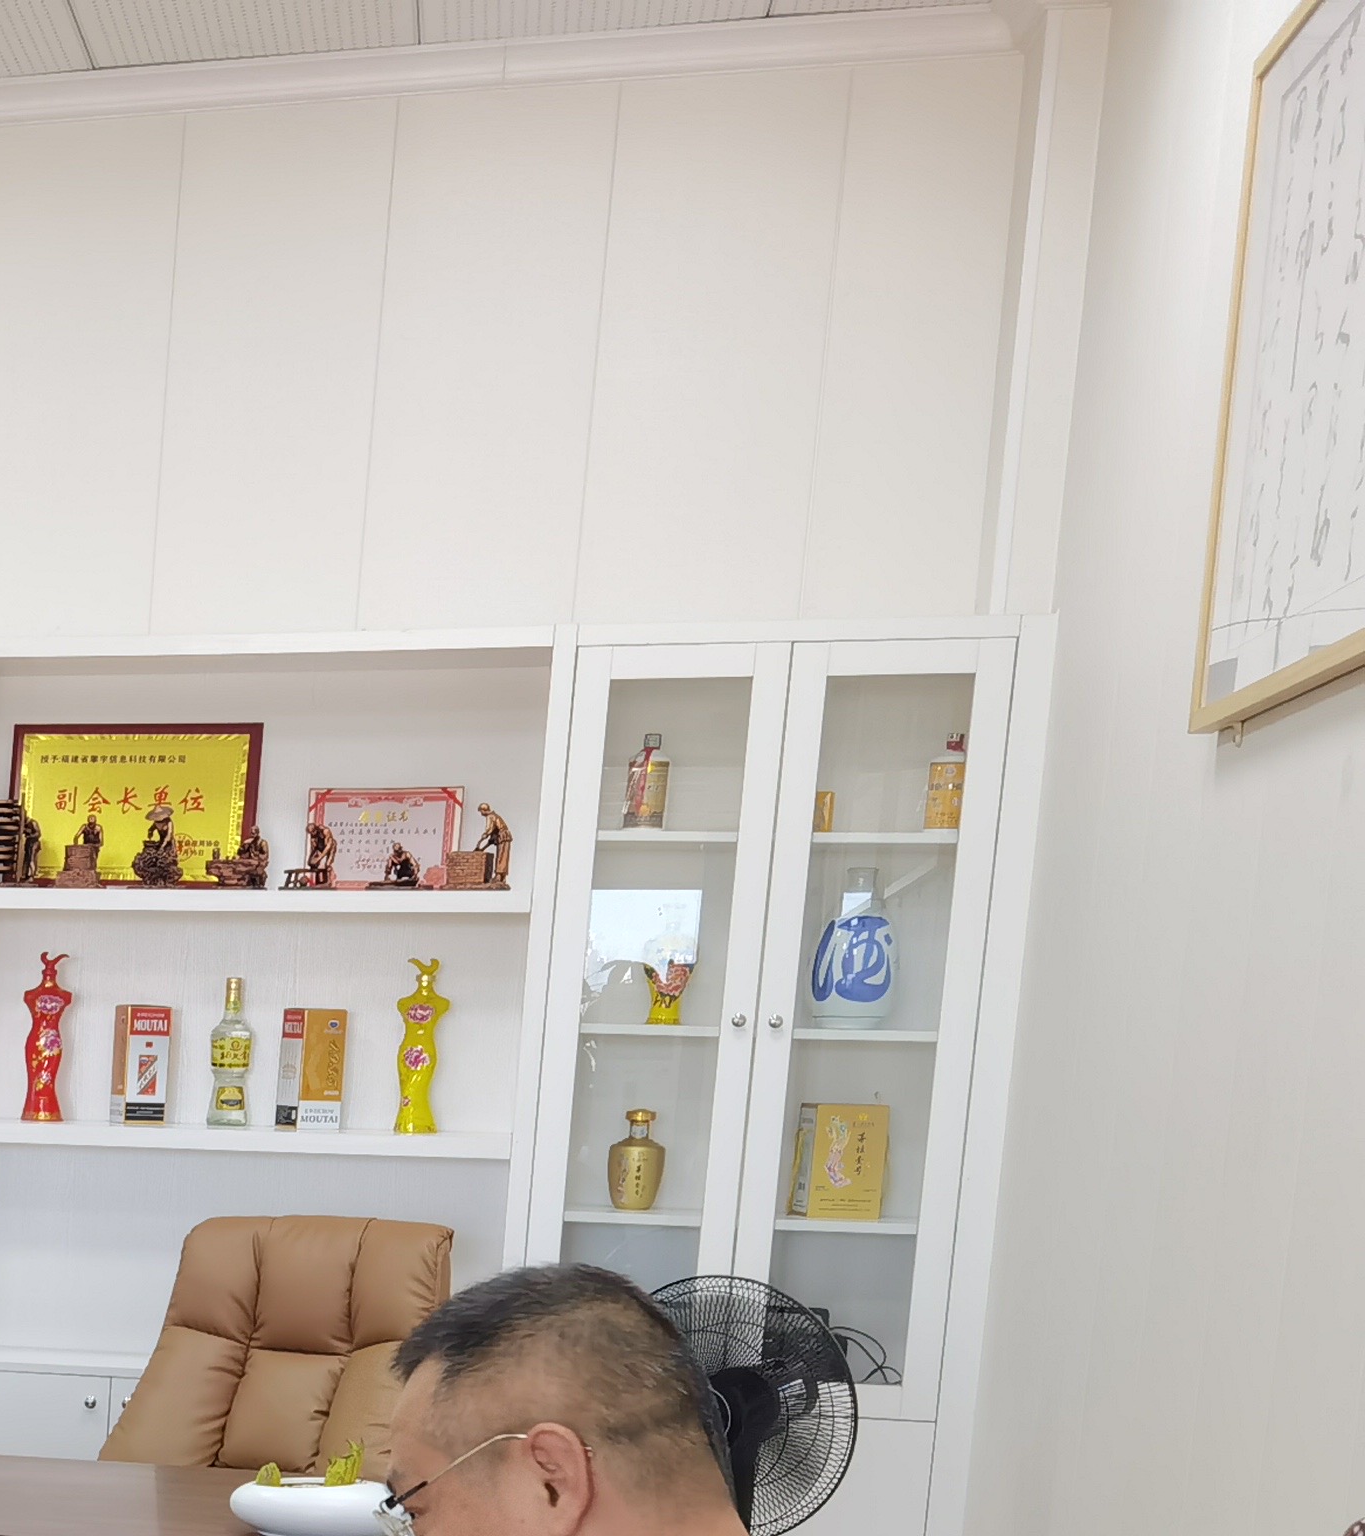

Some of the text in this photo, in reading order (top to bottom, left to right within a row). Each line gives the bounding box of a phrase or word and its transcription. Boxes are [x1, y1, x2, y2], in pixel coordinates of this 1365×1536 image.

[55, 784, 206, 815] 副会长单位
[133, 1019, 168, 1032] MOUTAI
[299, 1115, 339, 1124] MOUTAI
